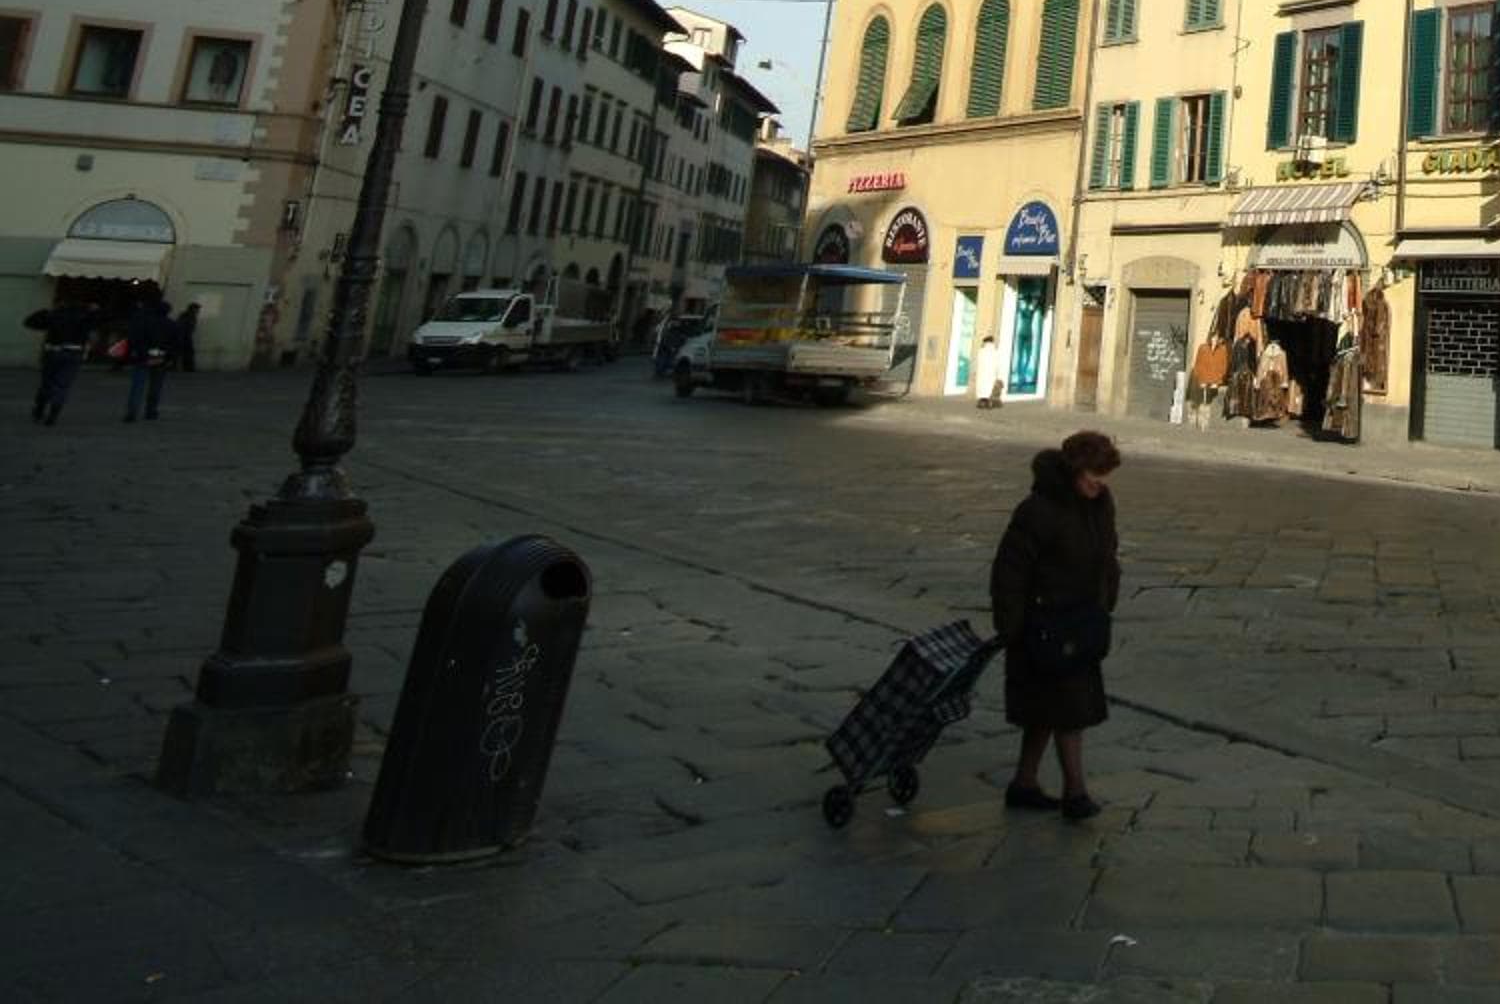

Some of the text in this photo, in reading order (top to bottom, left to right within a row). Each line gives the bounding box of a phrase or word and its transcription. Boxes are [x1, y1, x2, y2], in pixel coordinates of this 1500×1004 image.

[1422, 147, 1500, 174] GIADA
[848, 172, 906, 193] PIZZERIA
[885, 211, 927, 248] RISTORANTE
[1423, 276, 1500, 291] PELLETTERIA
